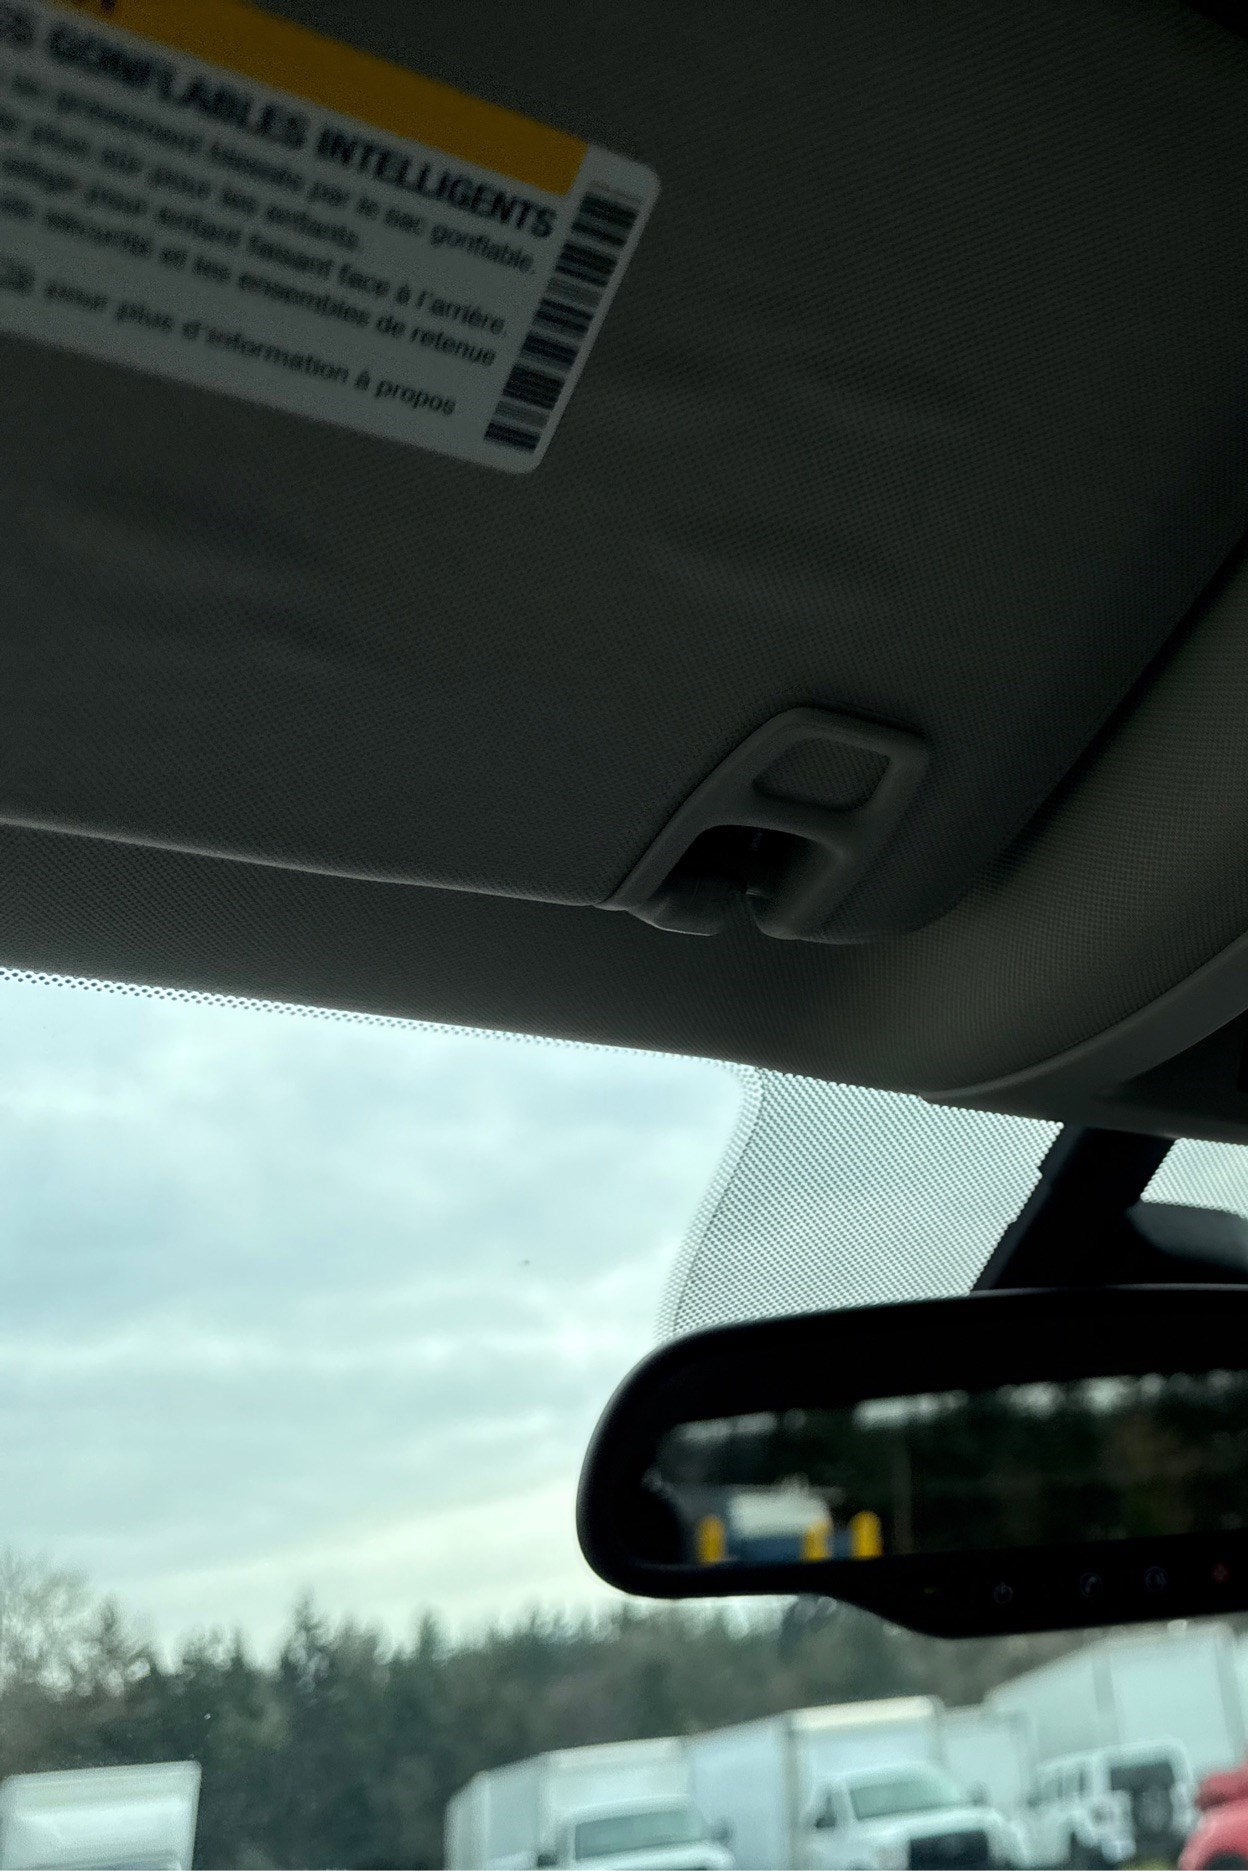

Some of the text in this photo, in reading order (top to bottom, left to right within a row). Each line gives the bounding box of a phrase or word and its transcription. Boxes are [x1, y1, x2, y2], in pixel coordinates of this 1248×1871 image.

[308, 180, 351, 210] par
[357, 195, 383, 218] le
[385, 207, 423, 234] sac
[430, 222, 539, 276] gonflable.
[315, 124, 556, 239] INTELLIGENTS
[238, 271, 371, 328] ensembles
[375, 312, 406, 337] de
[411, 325, 496, 366] retenue
[338, 263, 392, 297] face
[396, 282, 412, 304] à
[116, 300, 175, 334] plus
[355, 368, 371, 390] à
[375, 378, 456, 418] propos
